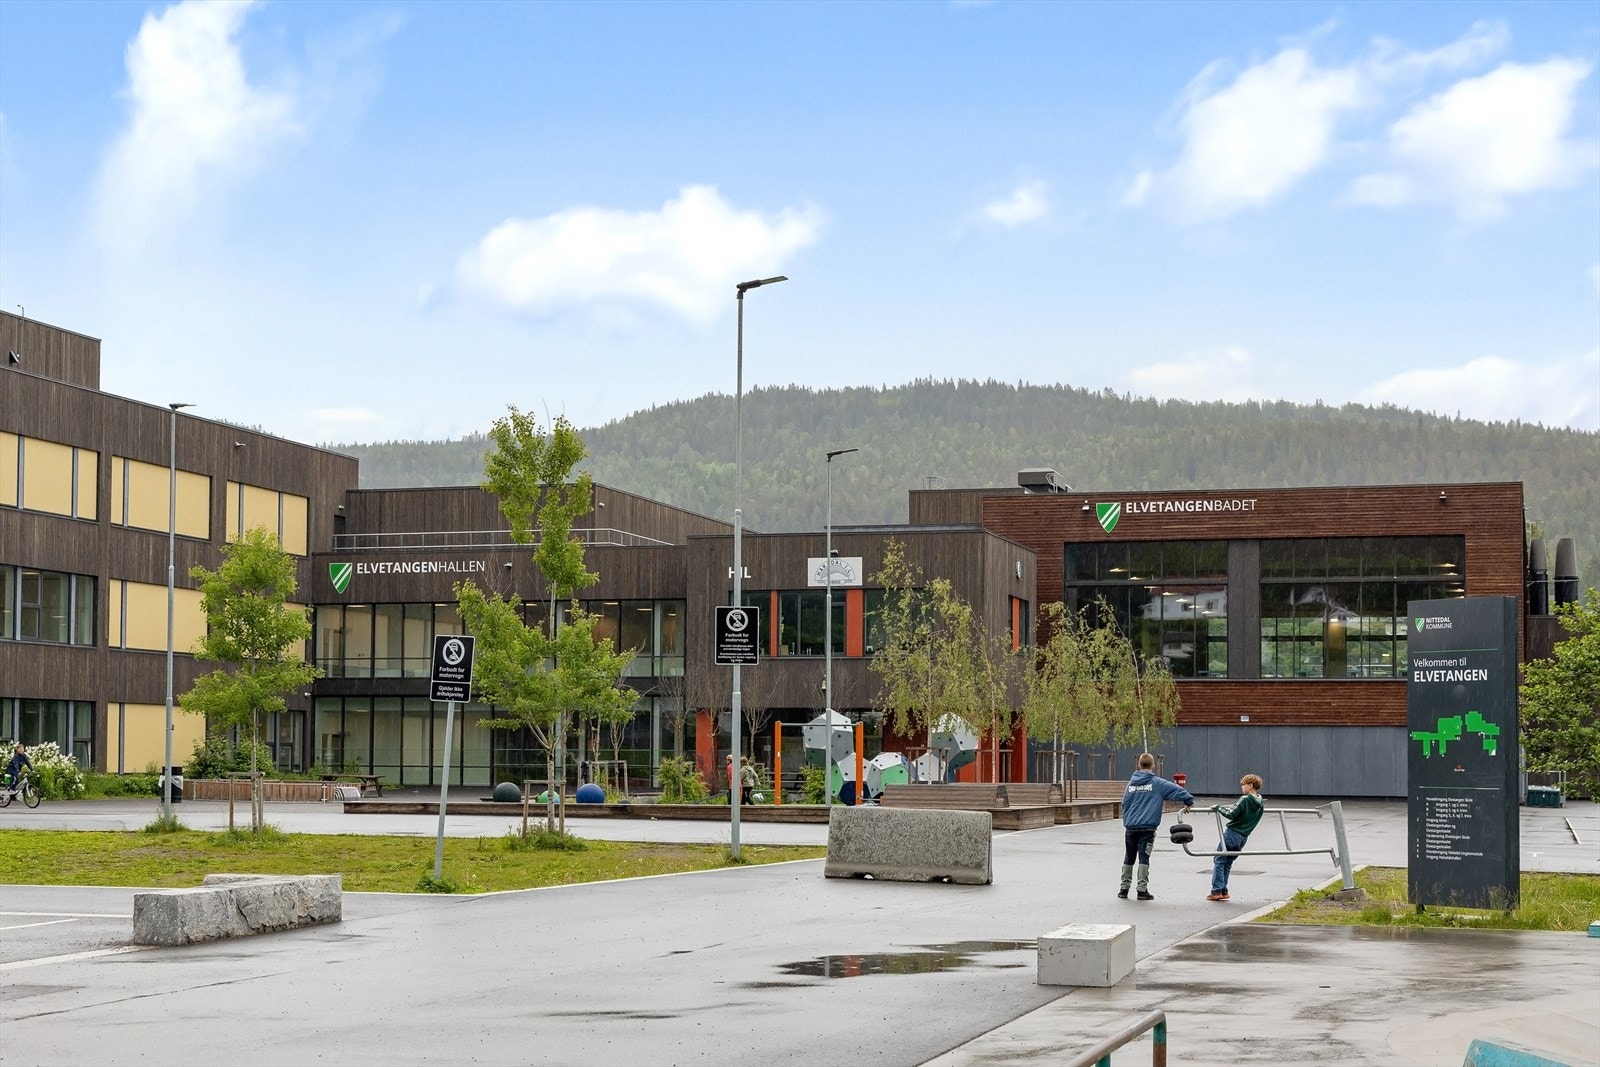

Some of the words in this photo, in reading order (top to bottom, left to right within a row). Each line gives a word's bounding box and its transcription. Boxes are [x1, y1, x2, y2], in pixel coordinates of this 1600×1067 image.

[1125, 499, 1257, 513] ELVETANGENBADET
[356, 560, 485, 574] ELVETANGENHALLEN
[1425, 622, 1453, 630] KOMMUNE
[1413, 658, 1458, 668] Velkommen
[1459, 656, 1467, 666] til
[1414, 668, 1488, 682] ELVETANGEN
